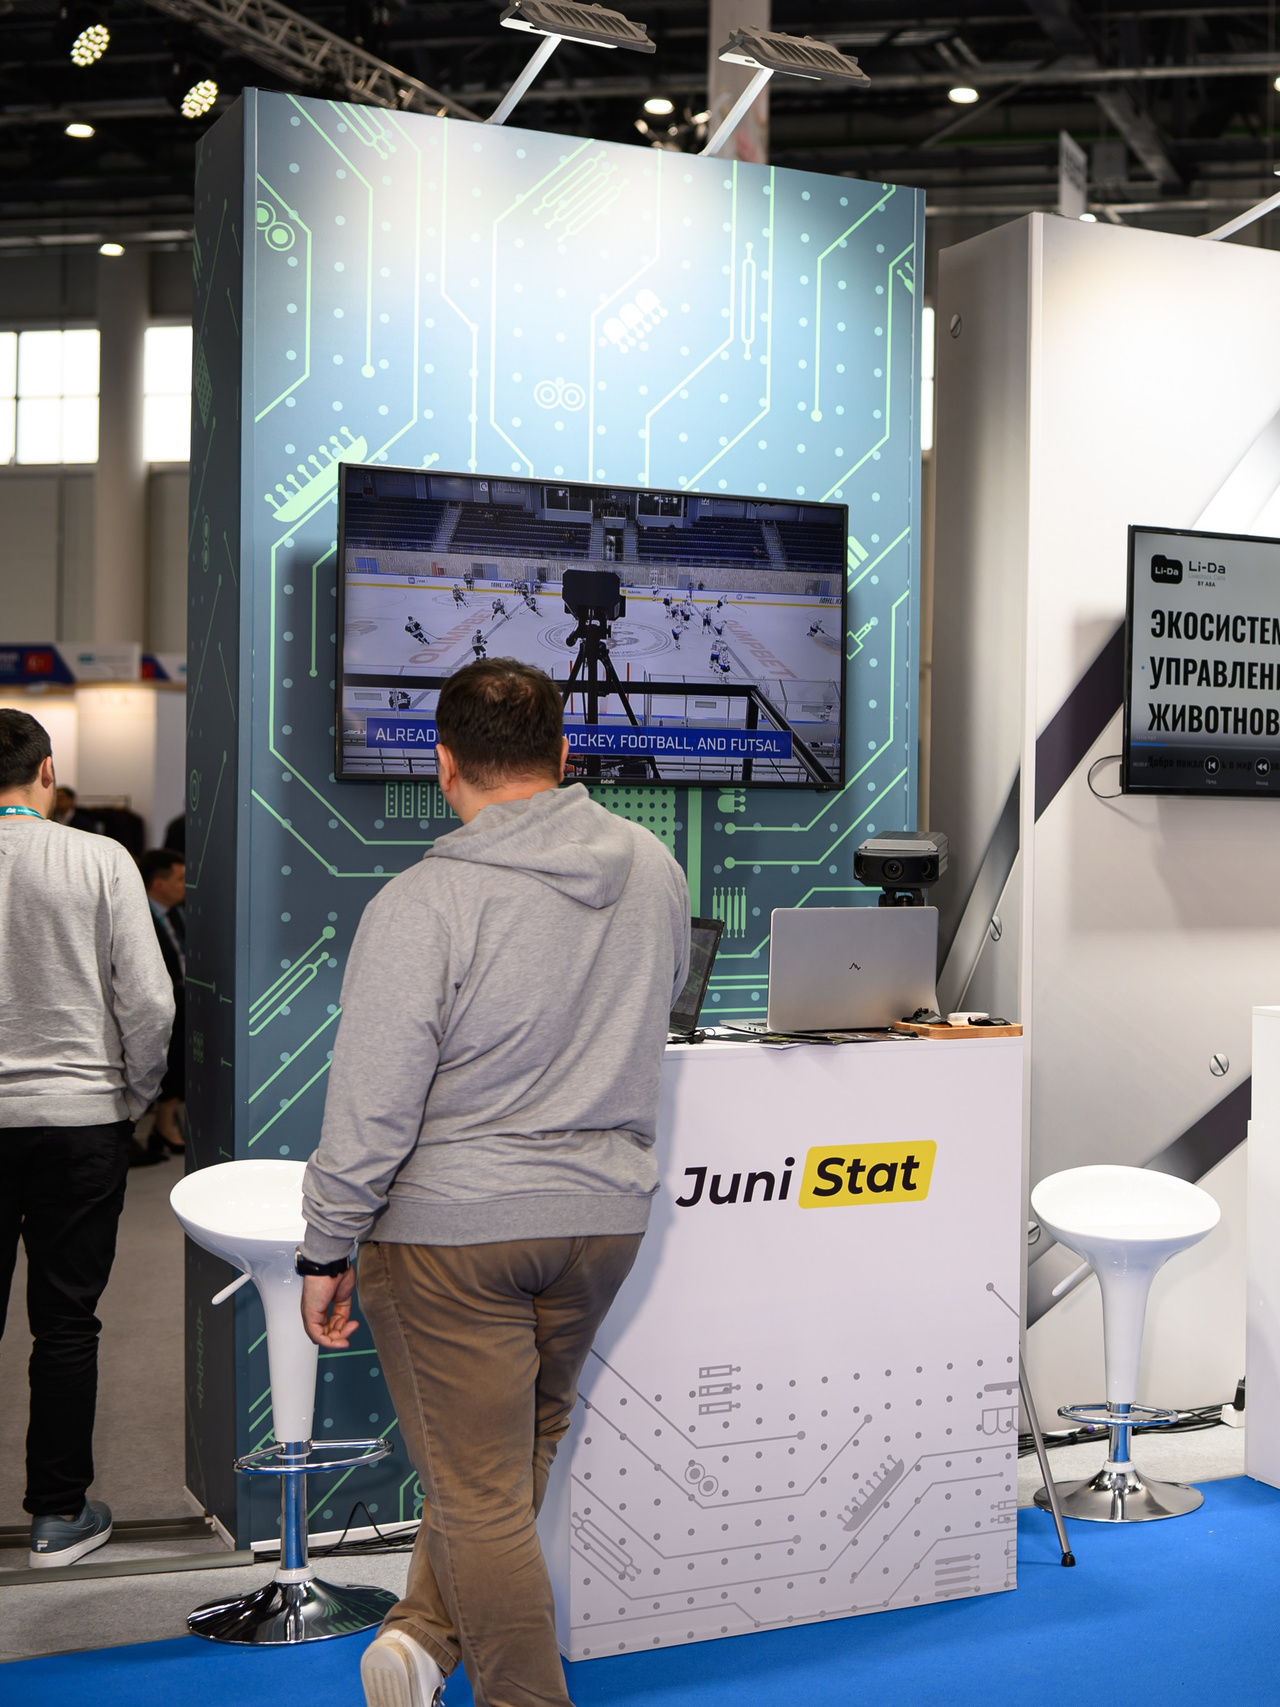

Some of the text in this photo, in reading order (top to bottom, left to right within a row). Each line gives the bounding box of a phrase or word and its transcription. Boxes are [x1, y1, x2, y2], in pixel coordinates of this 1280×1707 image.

[1155, 567, 1179, 576] Li-Da
[1188, 560, 1226, 574] Li-Da
[375, 727, 781, 752] ALREAD OCKEY, FOOTBALL, AND FUTSAL
[675, 1155, 920, 1208] Juni Stat
